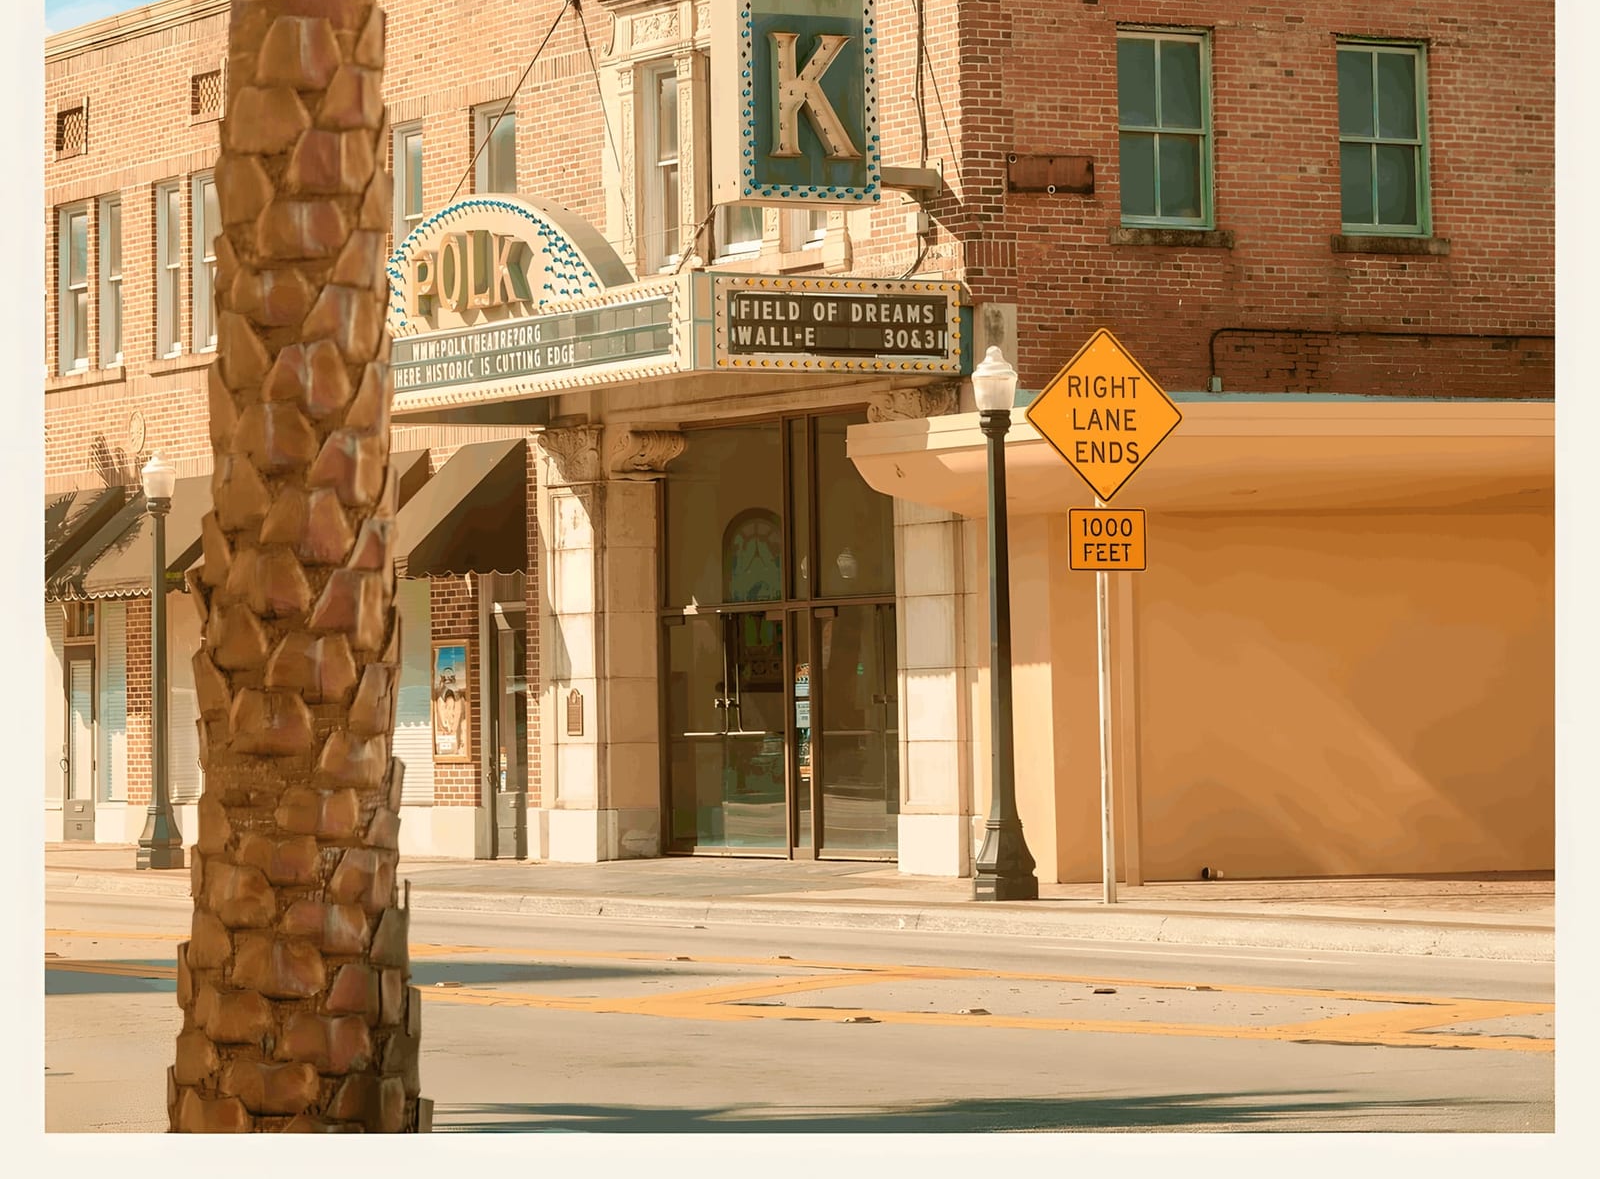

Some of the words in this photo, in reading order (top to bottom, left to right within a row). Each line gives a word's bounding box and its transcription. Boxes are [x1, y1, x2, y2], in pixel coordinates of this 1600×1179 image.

[411, 230, 534, 318] POLK
[740, 300, 800, 321] FIELD
[813, 302, 838, 322] OF
[851, 303, 935, 324] DREAMS
[737, 326, 816, 347] WALL-E
[426, 359, 474, 383] HISTORIC
[480, 357, 490, 376] IS
[496, 349, 541, 373] CUTTING
[547, 344, 575, 366] EDGE
[1067, 375, 1141, 399] RIGHT
[1073, 408, 1137, 432] LANE
[1075, 441, 1140, 465] ENDS
[1082, 518, 1133, 537] 1000
[1083, 543, 1132, 562] FEET
